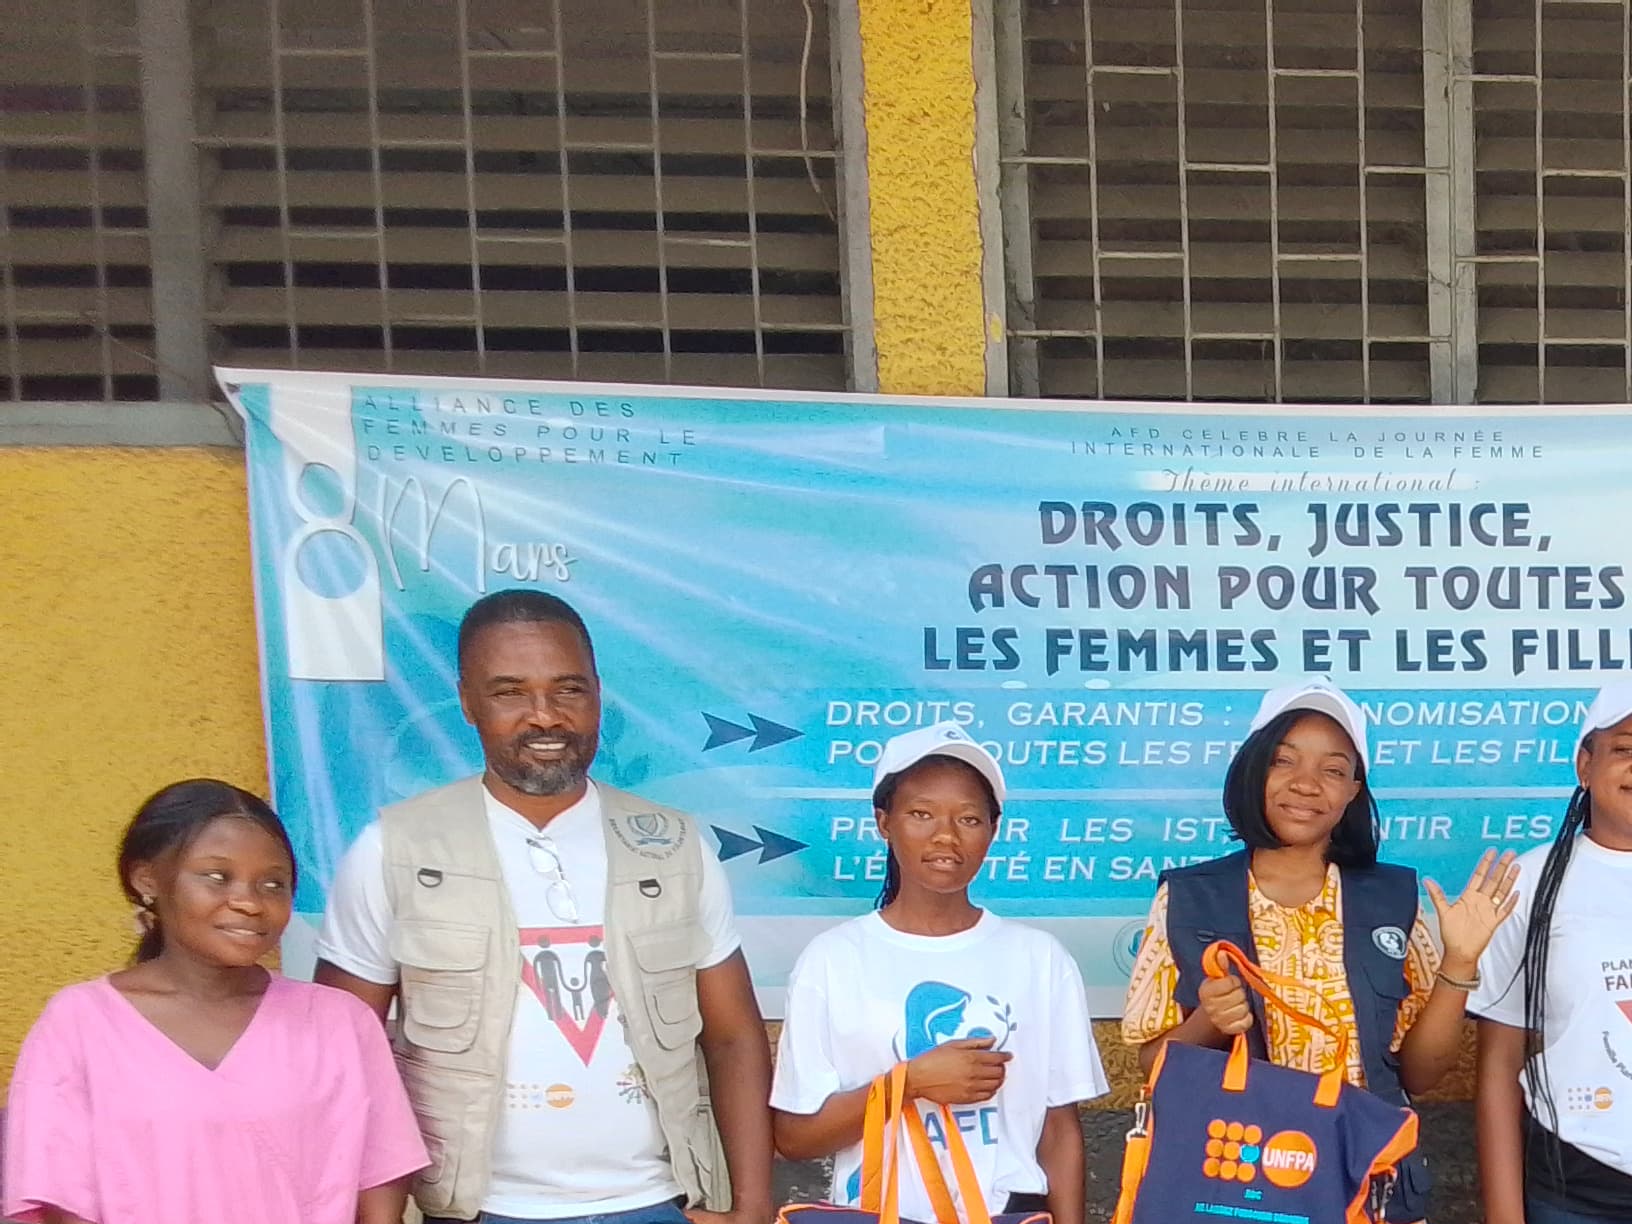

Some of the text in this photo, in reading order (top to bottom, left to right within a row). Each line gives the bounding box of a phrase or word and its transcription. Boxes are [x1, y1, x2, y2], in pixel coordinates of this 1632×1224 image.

[363, 396, 635, 418] ALLIANCE DES
[363, 419, 697, 446] FEMMES POUR LE
[1111, 426, 1161, 440] AFD
[1329, 429, 1358, 442] LA
[1378, 427, 1504, 443] JOURNÉE
[368, 445, 683, 465] DEVELOPPEMENT
[1071, 441, 1545, 459] INTERNATIONALE DE LA FEMME
[1270, 469, 1457, 493] international
[375, 471, 580, 593] Mars
[1037, 500, 1552, 557] DROITS, JUSTICE,
[968, 564, 1627, 616] ACTION POUR TOUTES
[923, 626, 1021, 672] LES
[1045, 627, 1280, 676] FEMMES
[1302, 628, 1371, 673] ET
[1395, 628, 1488, 673] LES
[826, 701, 985, 729] DROITS,
[1008, 701, 1205, 727] GARANTIS
[1118, 740, 1193, 766] LES
[1373, 740, 1422, 765] ET
[1431, 740, 1504, 765] LES
[1060, 817, 1135, 843] LES
[1481, 814, 1554, 840] LES
[1044, 856, 1095, 881] EN
[1262, 1147, 1316, 1175] UNFPA
